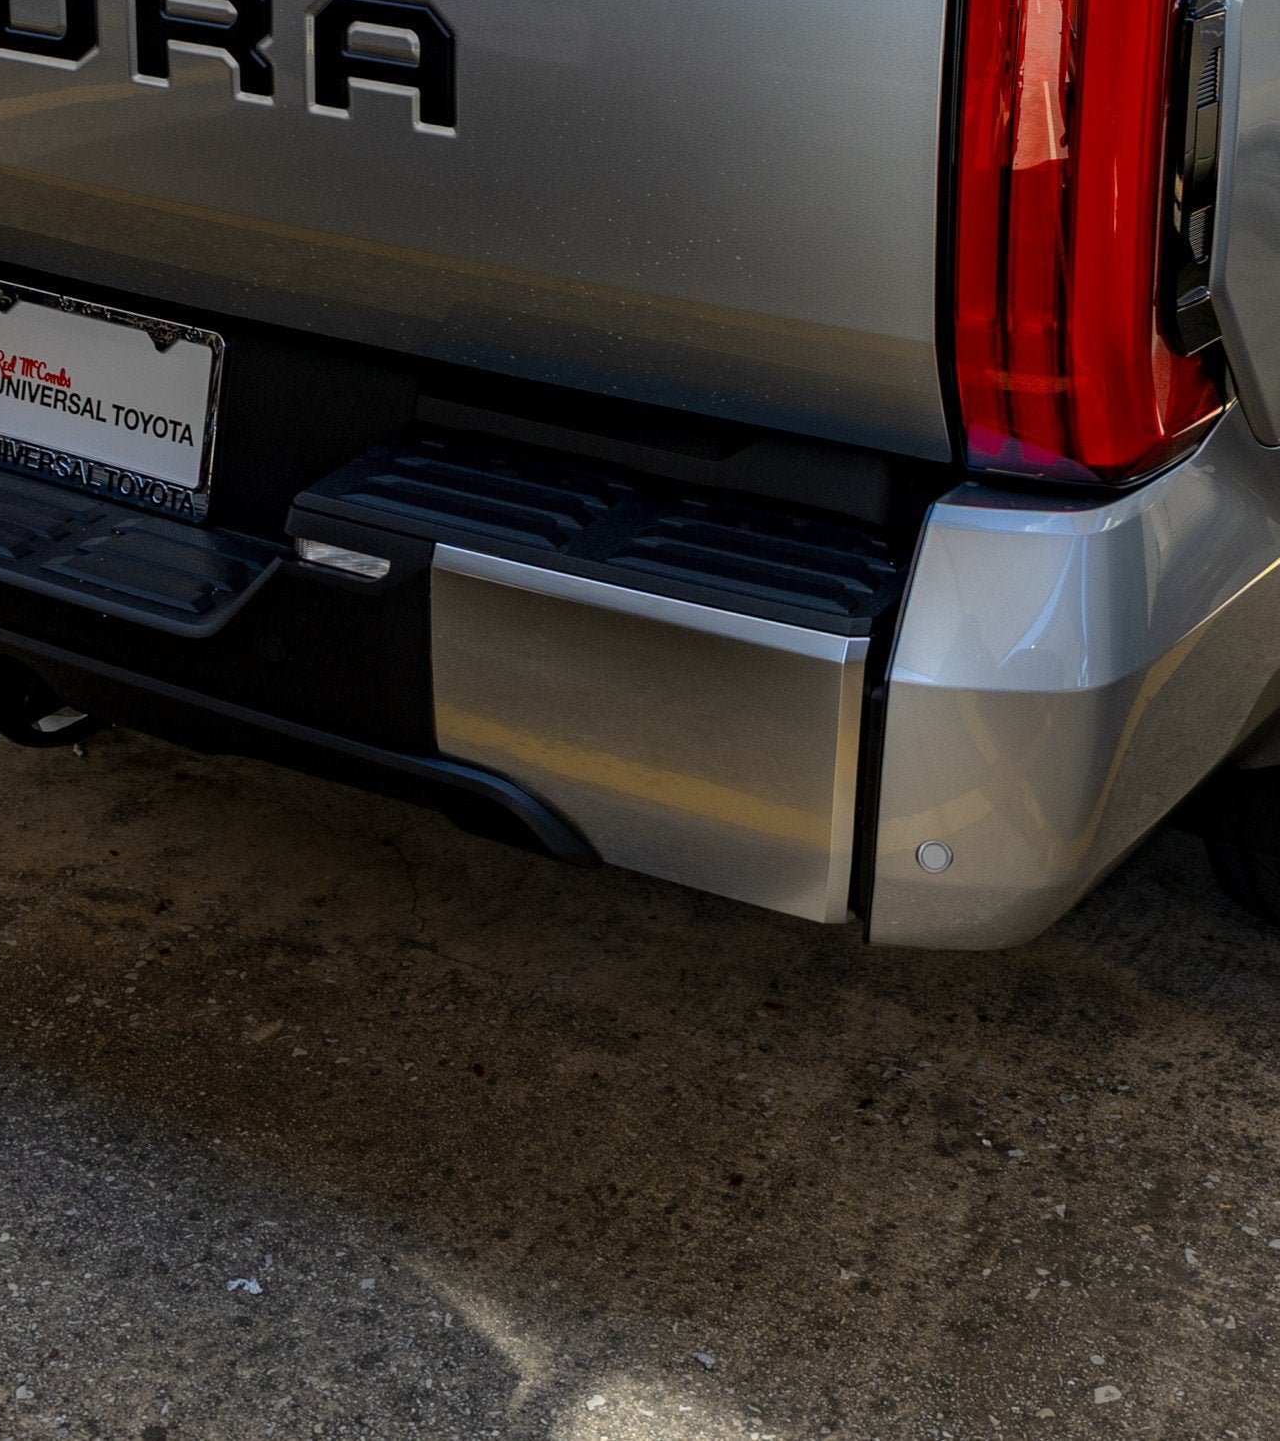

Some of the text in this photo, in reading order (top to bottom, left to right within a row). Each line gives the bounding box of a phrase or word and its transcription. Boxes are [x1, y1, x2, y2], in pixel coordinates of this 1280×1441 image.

[19, 356, 71, 389] McCombs
[112, 404, 195, 448] TOYOTA
[104, 468, 197, 517] TOYOTA
